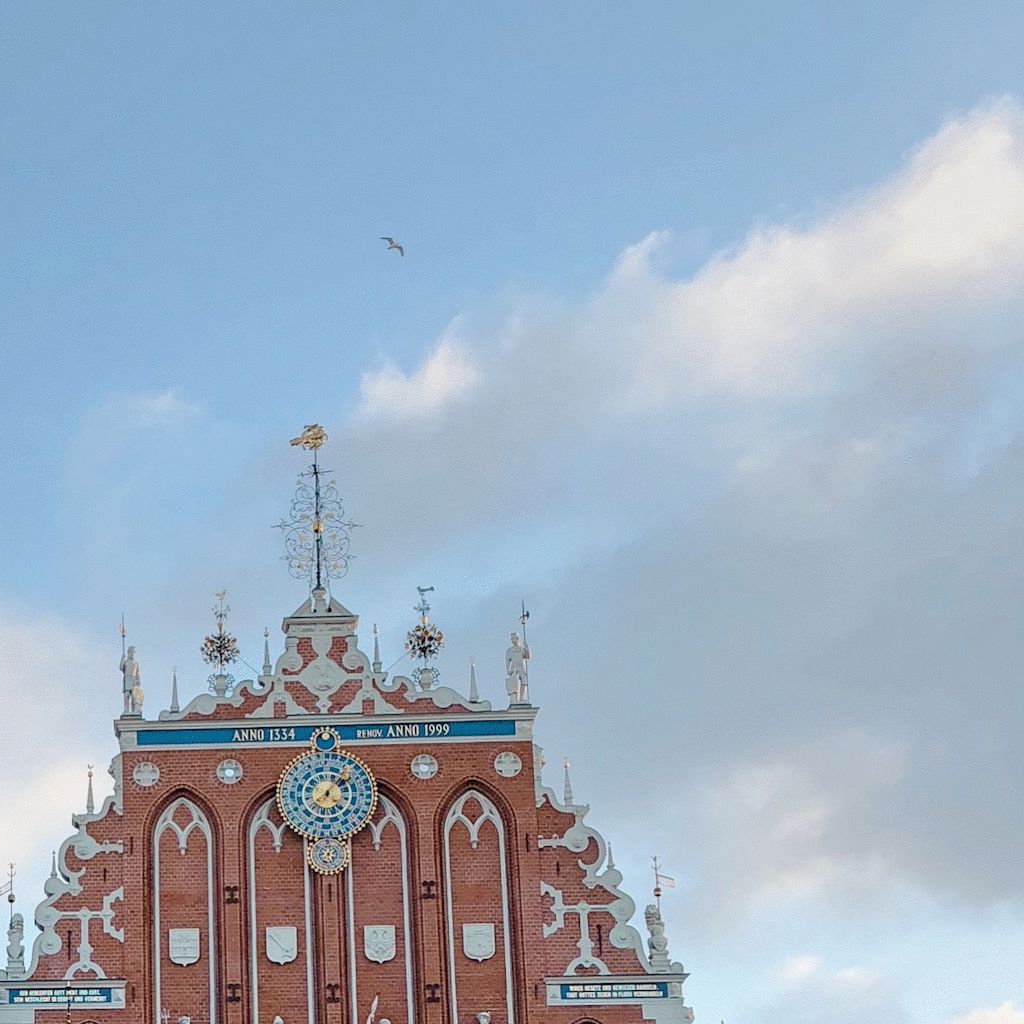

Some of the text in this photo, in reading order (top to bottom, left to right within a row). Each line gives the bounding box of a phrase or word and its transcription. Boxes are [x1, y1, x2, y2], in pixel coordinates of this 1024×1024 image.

[232, 728, 265, 741] ANNO
[269, 728, 296, 741] 1334
[386, 724, 419, 738] ANNO
[424, 723, 450, 736] 1999
